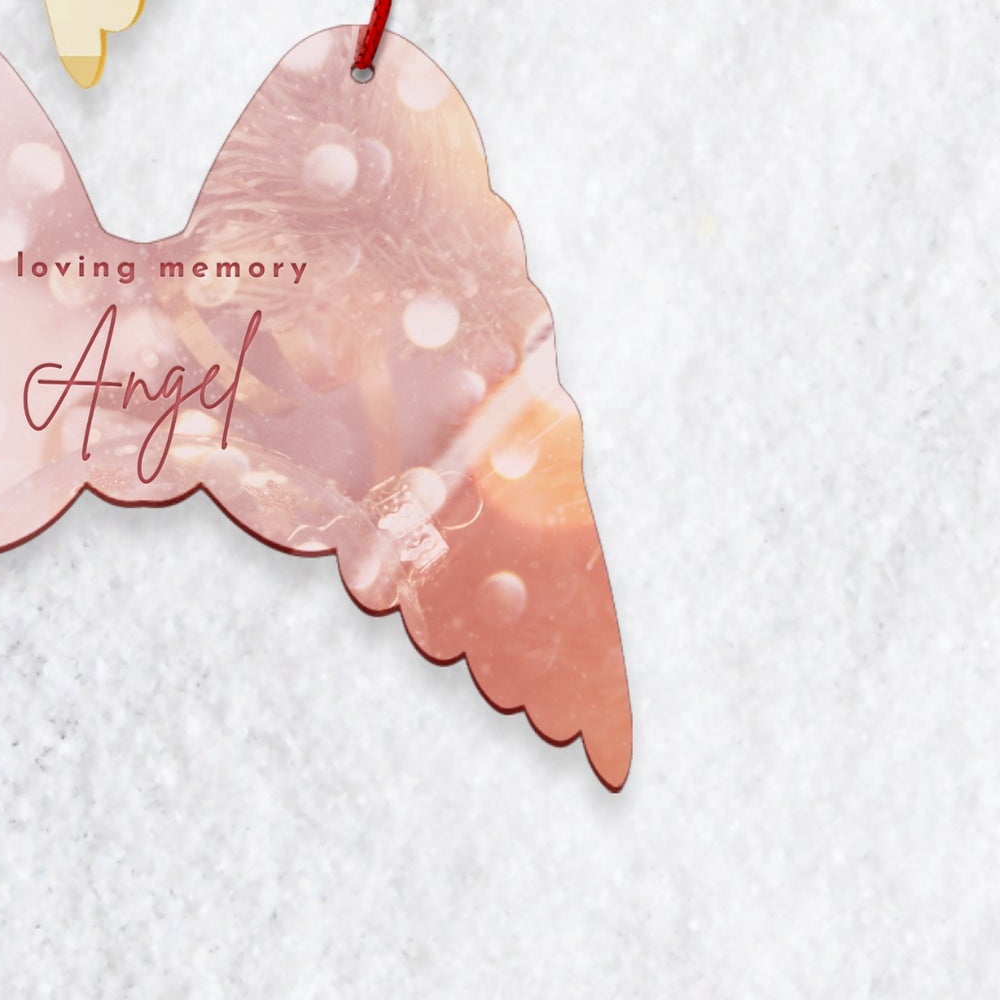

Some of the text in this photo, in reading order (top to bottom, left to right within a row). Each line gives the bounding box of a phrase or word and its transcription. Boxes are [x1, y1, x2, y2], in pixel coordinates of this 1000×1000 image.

[17, 251, 136, 284] loving
[160, 261, 308, 284] memory
[23, 303, 262, 484] Angel
